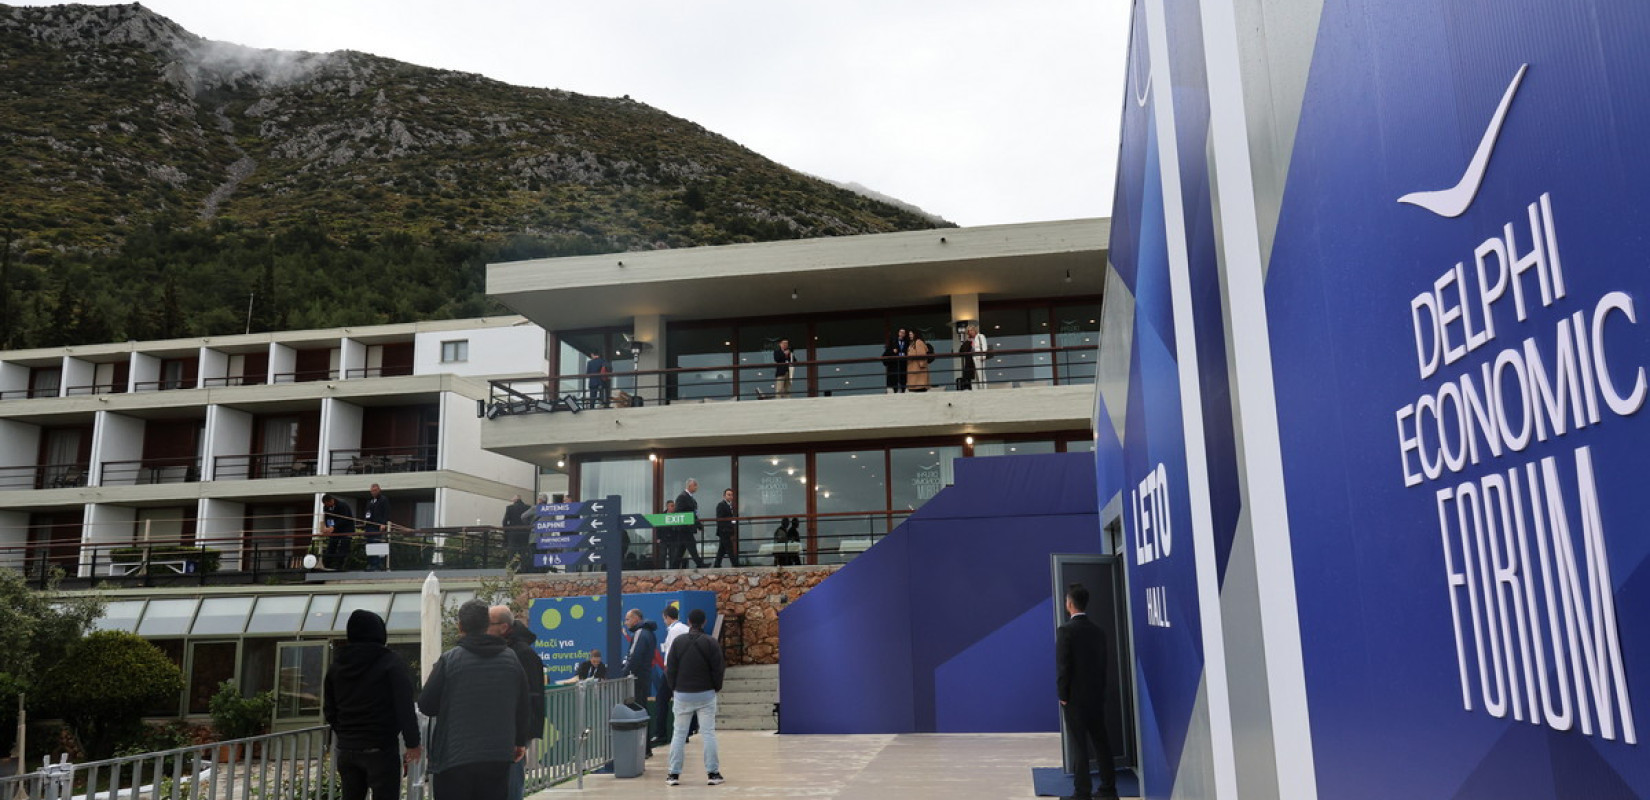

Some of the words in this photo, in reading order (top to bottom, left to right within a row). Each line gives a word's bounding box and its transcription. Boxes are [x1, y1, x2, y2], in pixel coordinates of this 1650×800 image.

[1411, 191, 1566, 379] DELPHI
[1396, 290, 1647, 487] ECONOMIC
[537, 520, 566, 530] DAPHNE
[541, 504, 570, 512] ARTEMIS
[665, 514, 684, 524] EXIT
[1132, 462, 1172, 566] LETO
[1145, 586, 1171, 627] HALL
[1436, 446, 1637, 745] FORUM
[535, 638, 558, 648] Μαζί
[560, 640, 574, 648] για
